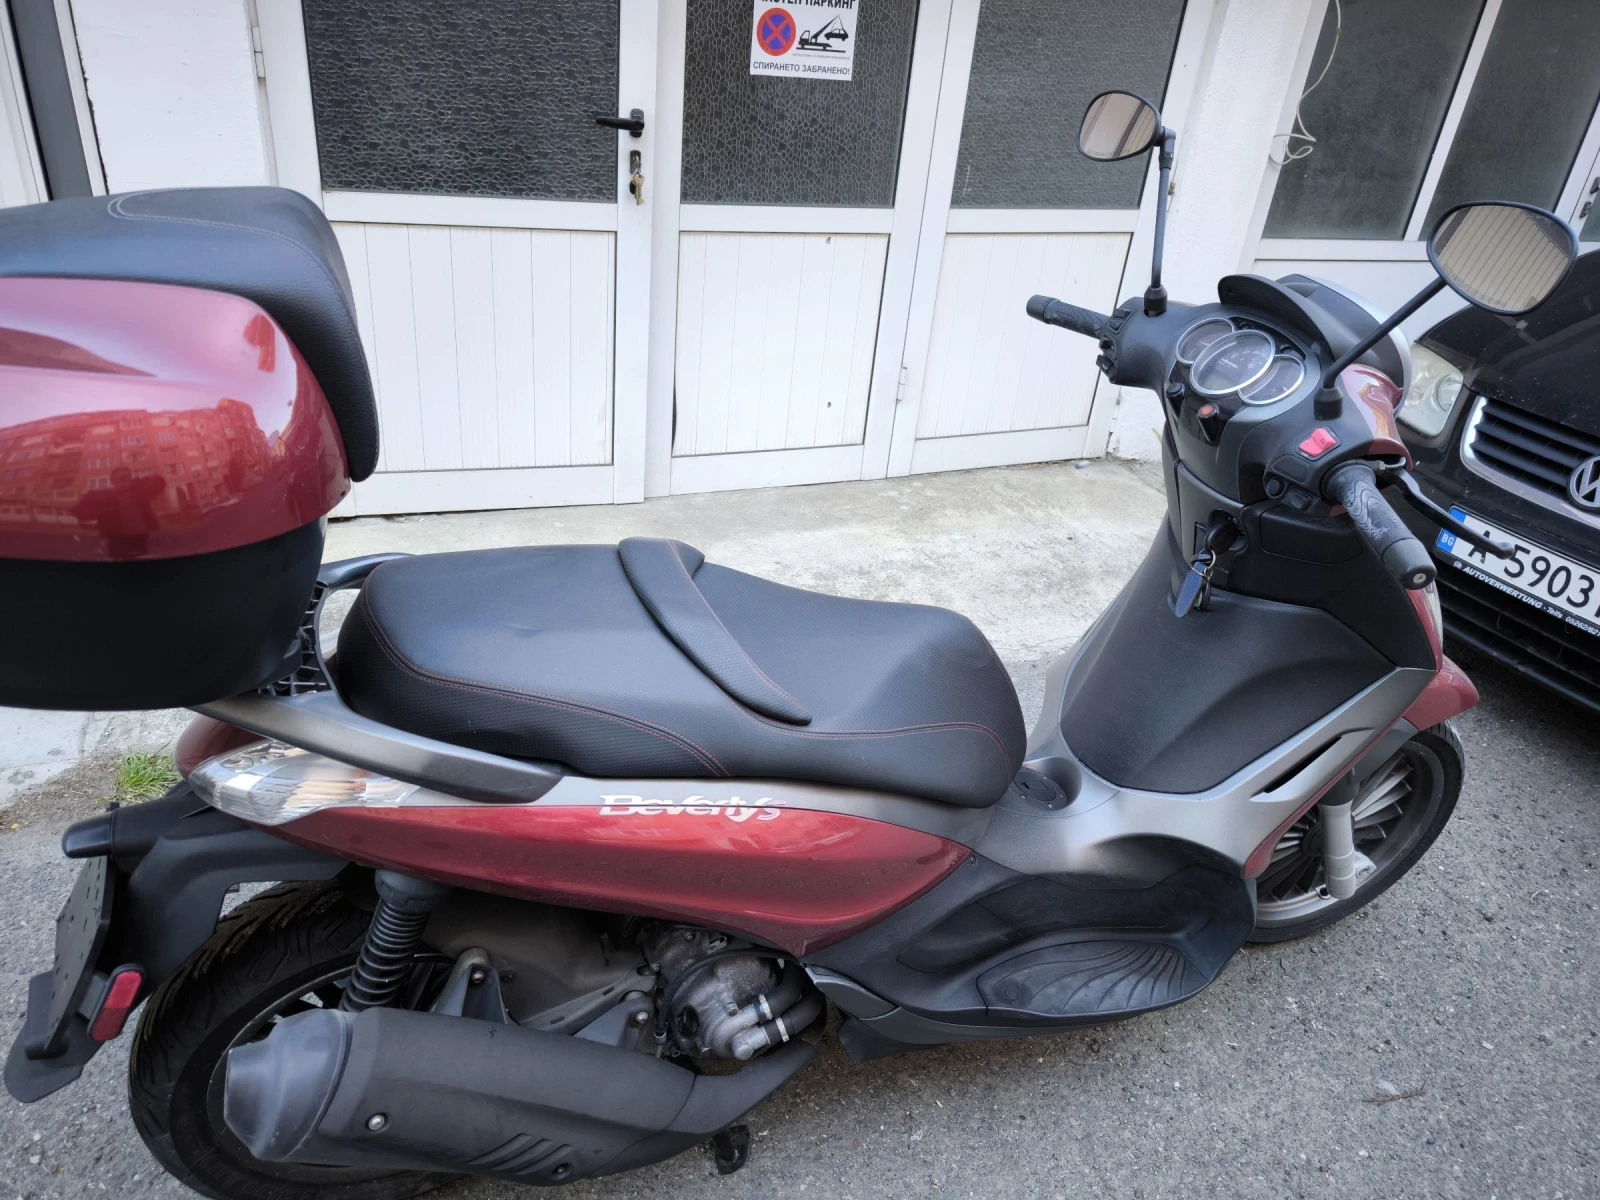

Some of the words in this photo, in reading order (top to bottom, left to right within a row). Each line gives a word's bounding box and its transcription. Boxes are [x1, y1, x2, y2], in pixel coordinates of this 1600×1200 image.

[753, 61, 800, 72] СПИРАНЕТО
[801, 64, 850, 75] ЗАБРАНЕНО!
[1441, 532, 1455, 547] BG
[1462, 566, 1543, 609] AUTOVERWERTUNG
